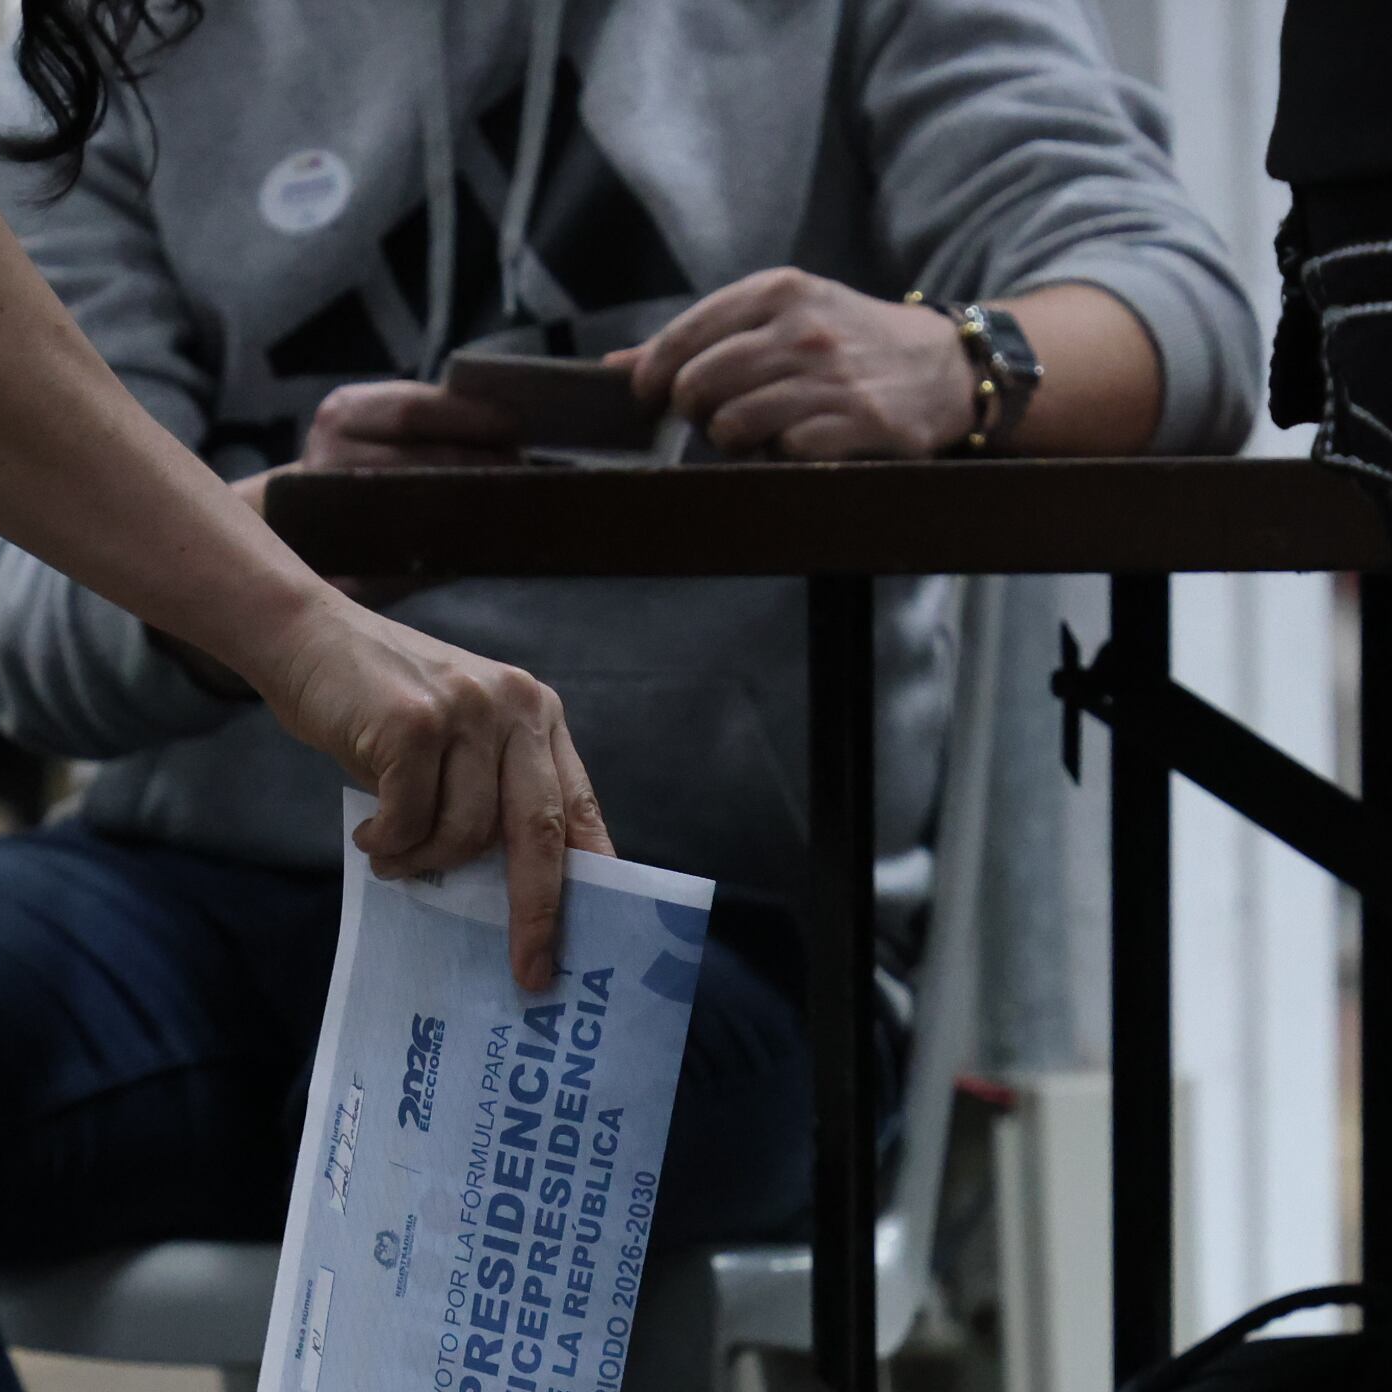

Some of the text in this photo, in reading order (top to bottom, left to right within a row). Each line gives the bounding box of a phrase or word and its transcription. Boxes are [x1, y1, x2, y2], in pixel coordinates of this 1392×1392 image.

[398, 1012, 436, 1129] 2026
[418, 1019, 446, 1133] ELECCIONES
[481, 1024, 512, 1093] PARA
[460, 1100, 498, 1226] FÓRMULA
[562, 1107, 625, 1319] REPÚBLICA
[455, 1231, 476, 1264] LA
[612, 1171, 657, 1309] 2026-2030
[444, 1270, 470, 1326] POR
[552, 1332, 583, 1378] LA
